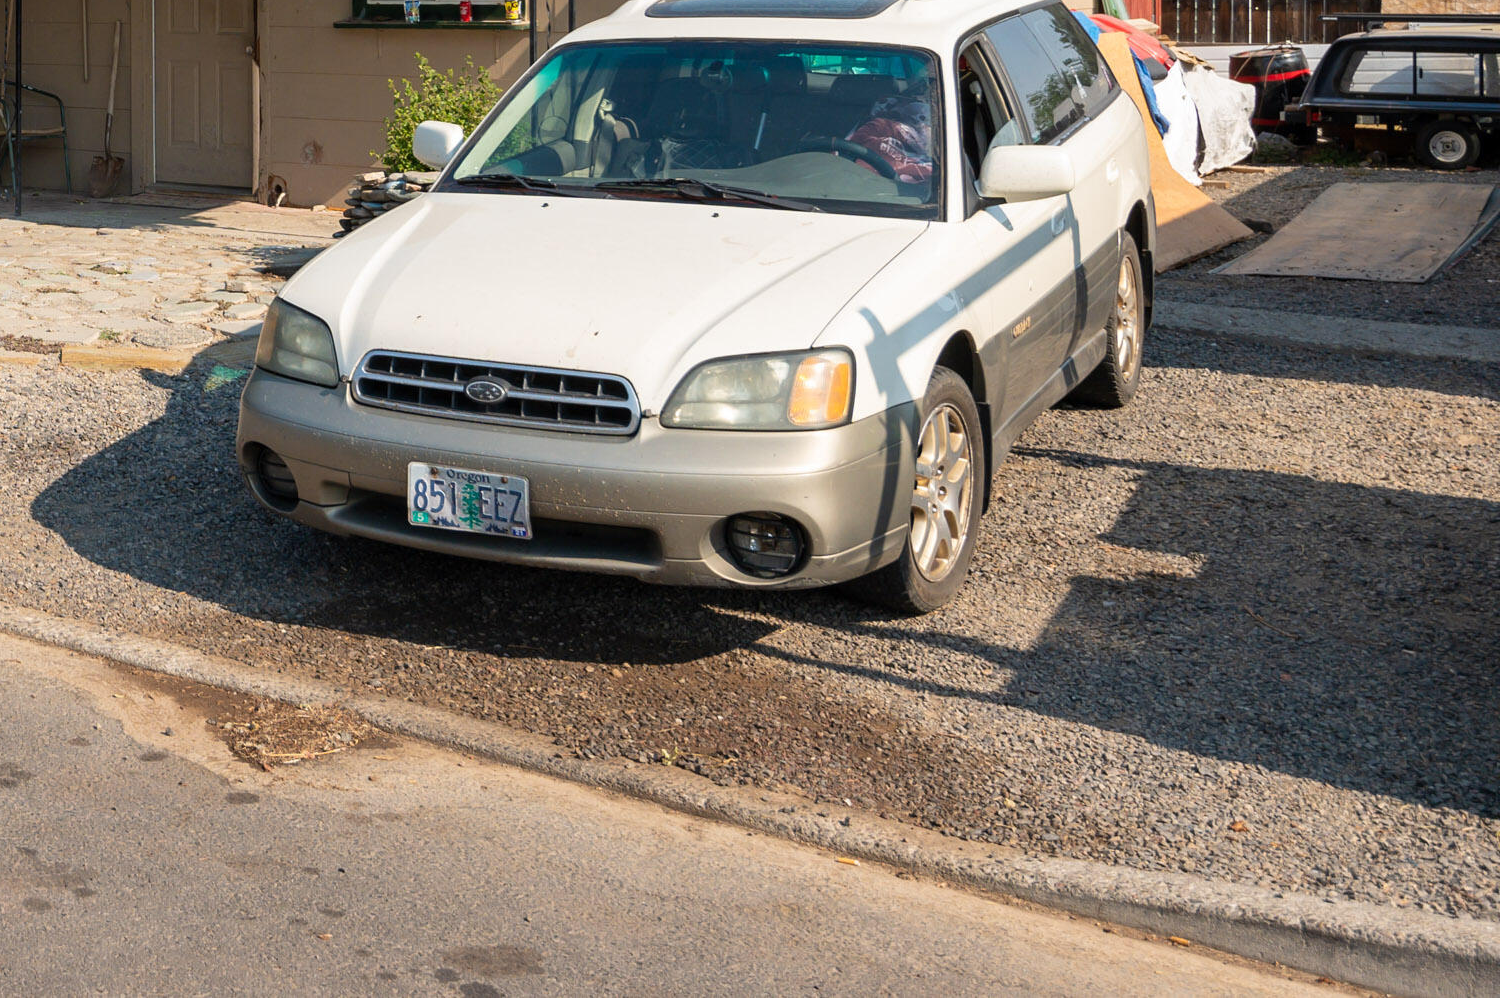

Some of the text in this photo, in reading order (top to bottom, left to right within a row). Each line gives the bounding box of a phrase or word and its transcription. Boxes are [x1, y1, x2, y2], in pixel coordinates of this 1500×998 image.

[446, 469, 490, 484] Oregon
[413, 479, 525, 525] 851 EEZ
[417, 512, 425, 522] 5
